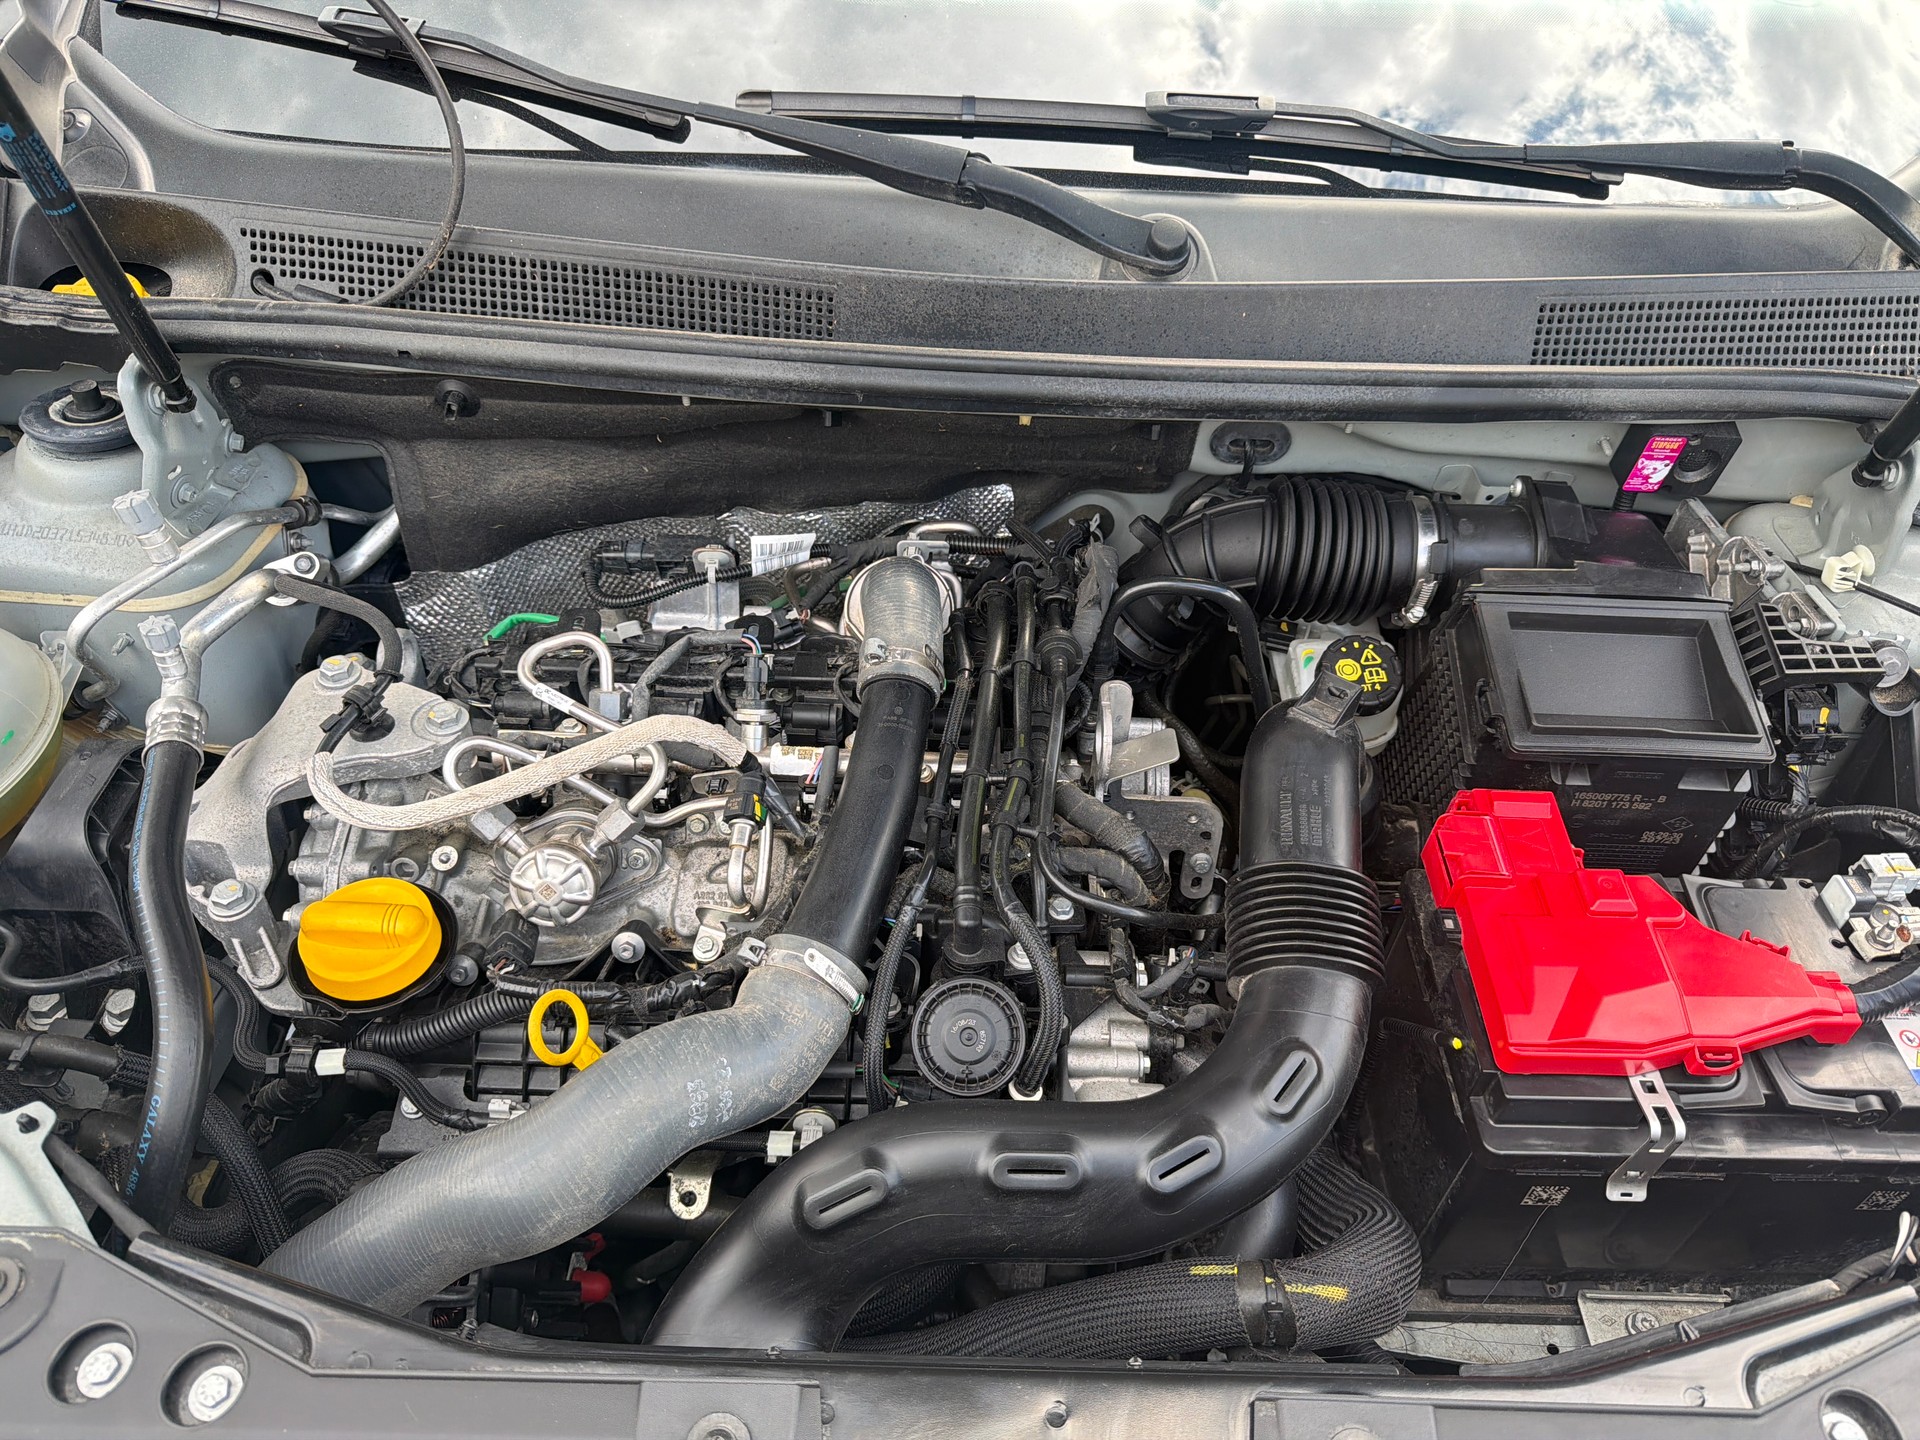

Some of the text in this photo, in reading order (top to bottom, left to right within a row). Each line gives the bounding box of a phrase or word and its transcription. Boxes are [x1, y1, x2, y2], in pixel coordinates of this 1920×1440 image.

[1574, 791, 1631, 802] 165009775
[1571, 799, 1653, 811] H 8201 173 592
[1280, 791, 1294, 846] RENAULT
[951, 1019, 976, 1033] 16/08/23
[126, 1094, 162, 1197] GALAXY 4886
